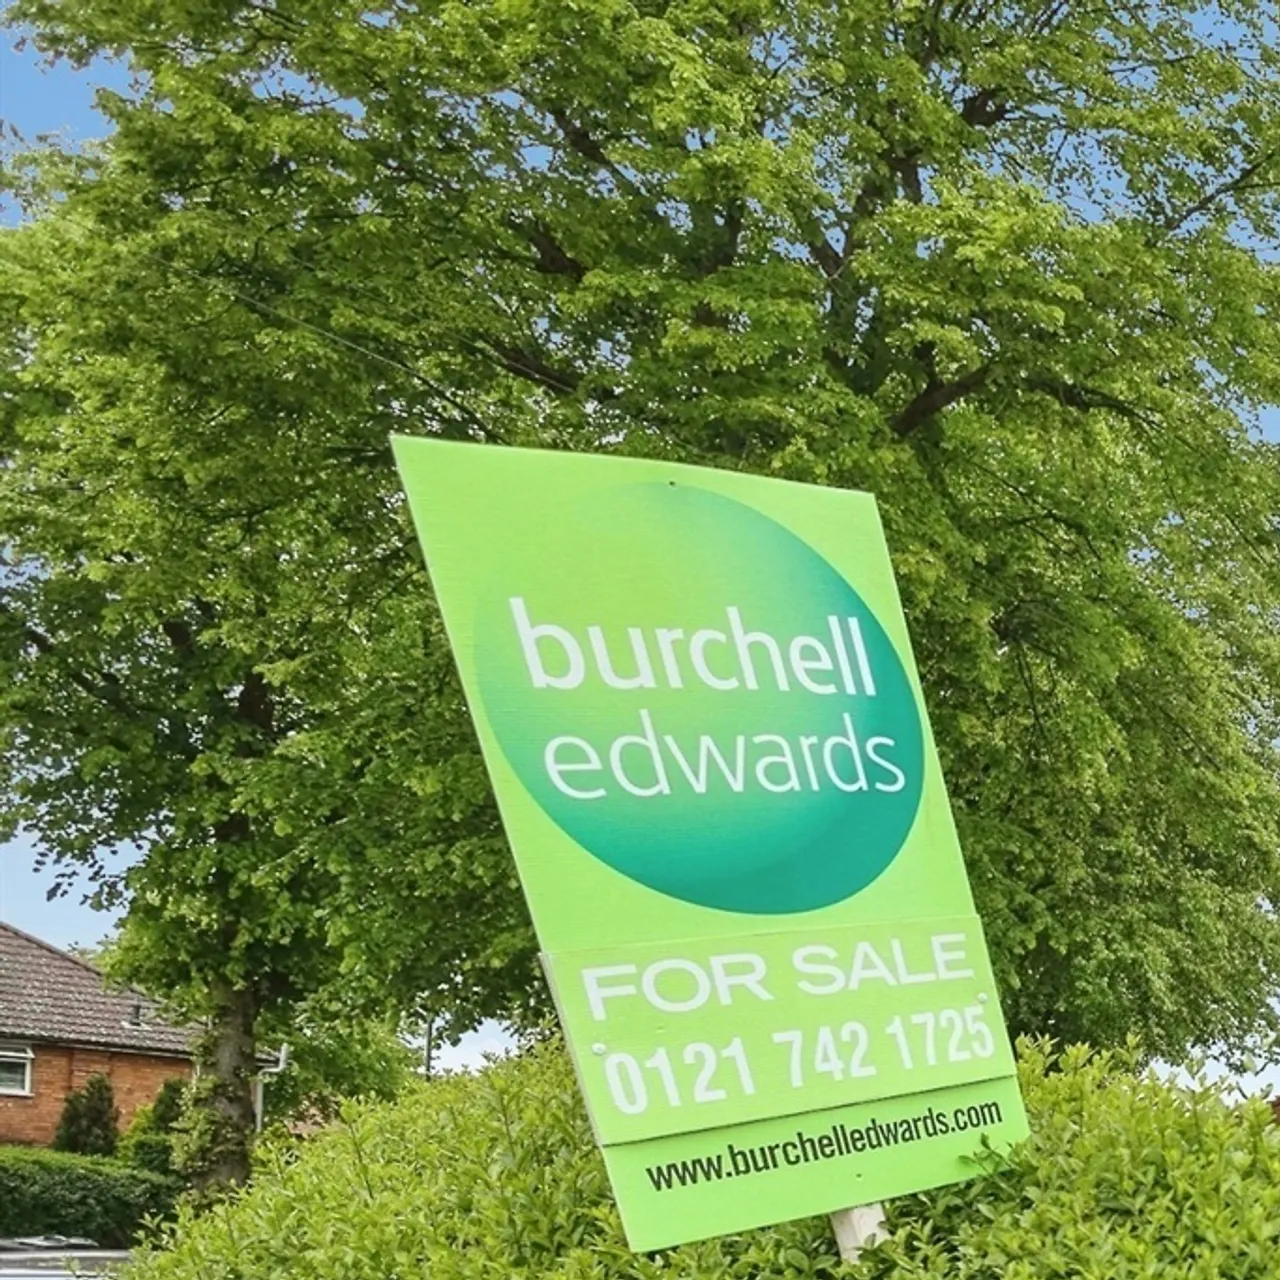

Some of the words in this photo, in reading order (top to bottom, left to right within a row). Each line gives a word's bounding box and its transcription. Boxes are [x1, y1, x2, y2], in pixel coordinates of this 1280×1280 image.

[509, 597, 877, 696] burchell
[544, 709, 906, 799] edwards
[581, 953, 774, 1021] FOR
[791, 933, 974, 995] SALE
[605, 1037, 756, 1115] 0121
[773, 1021, 876, 1088] 742
[885, 1005, 994, 1070] 1725
[646, 1101, 1003, 1191] www.burchelledwards.com
